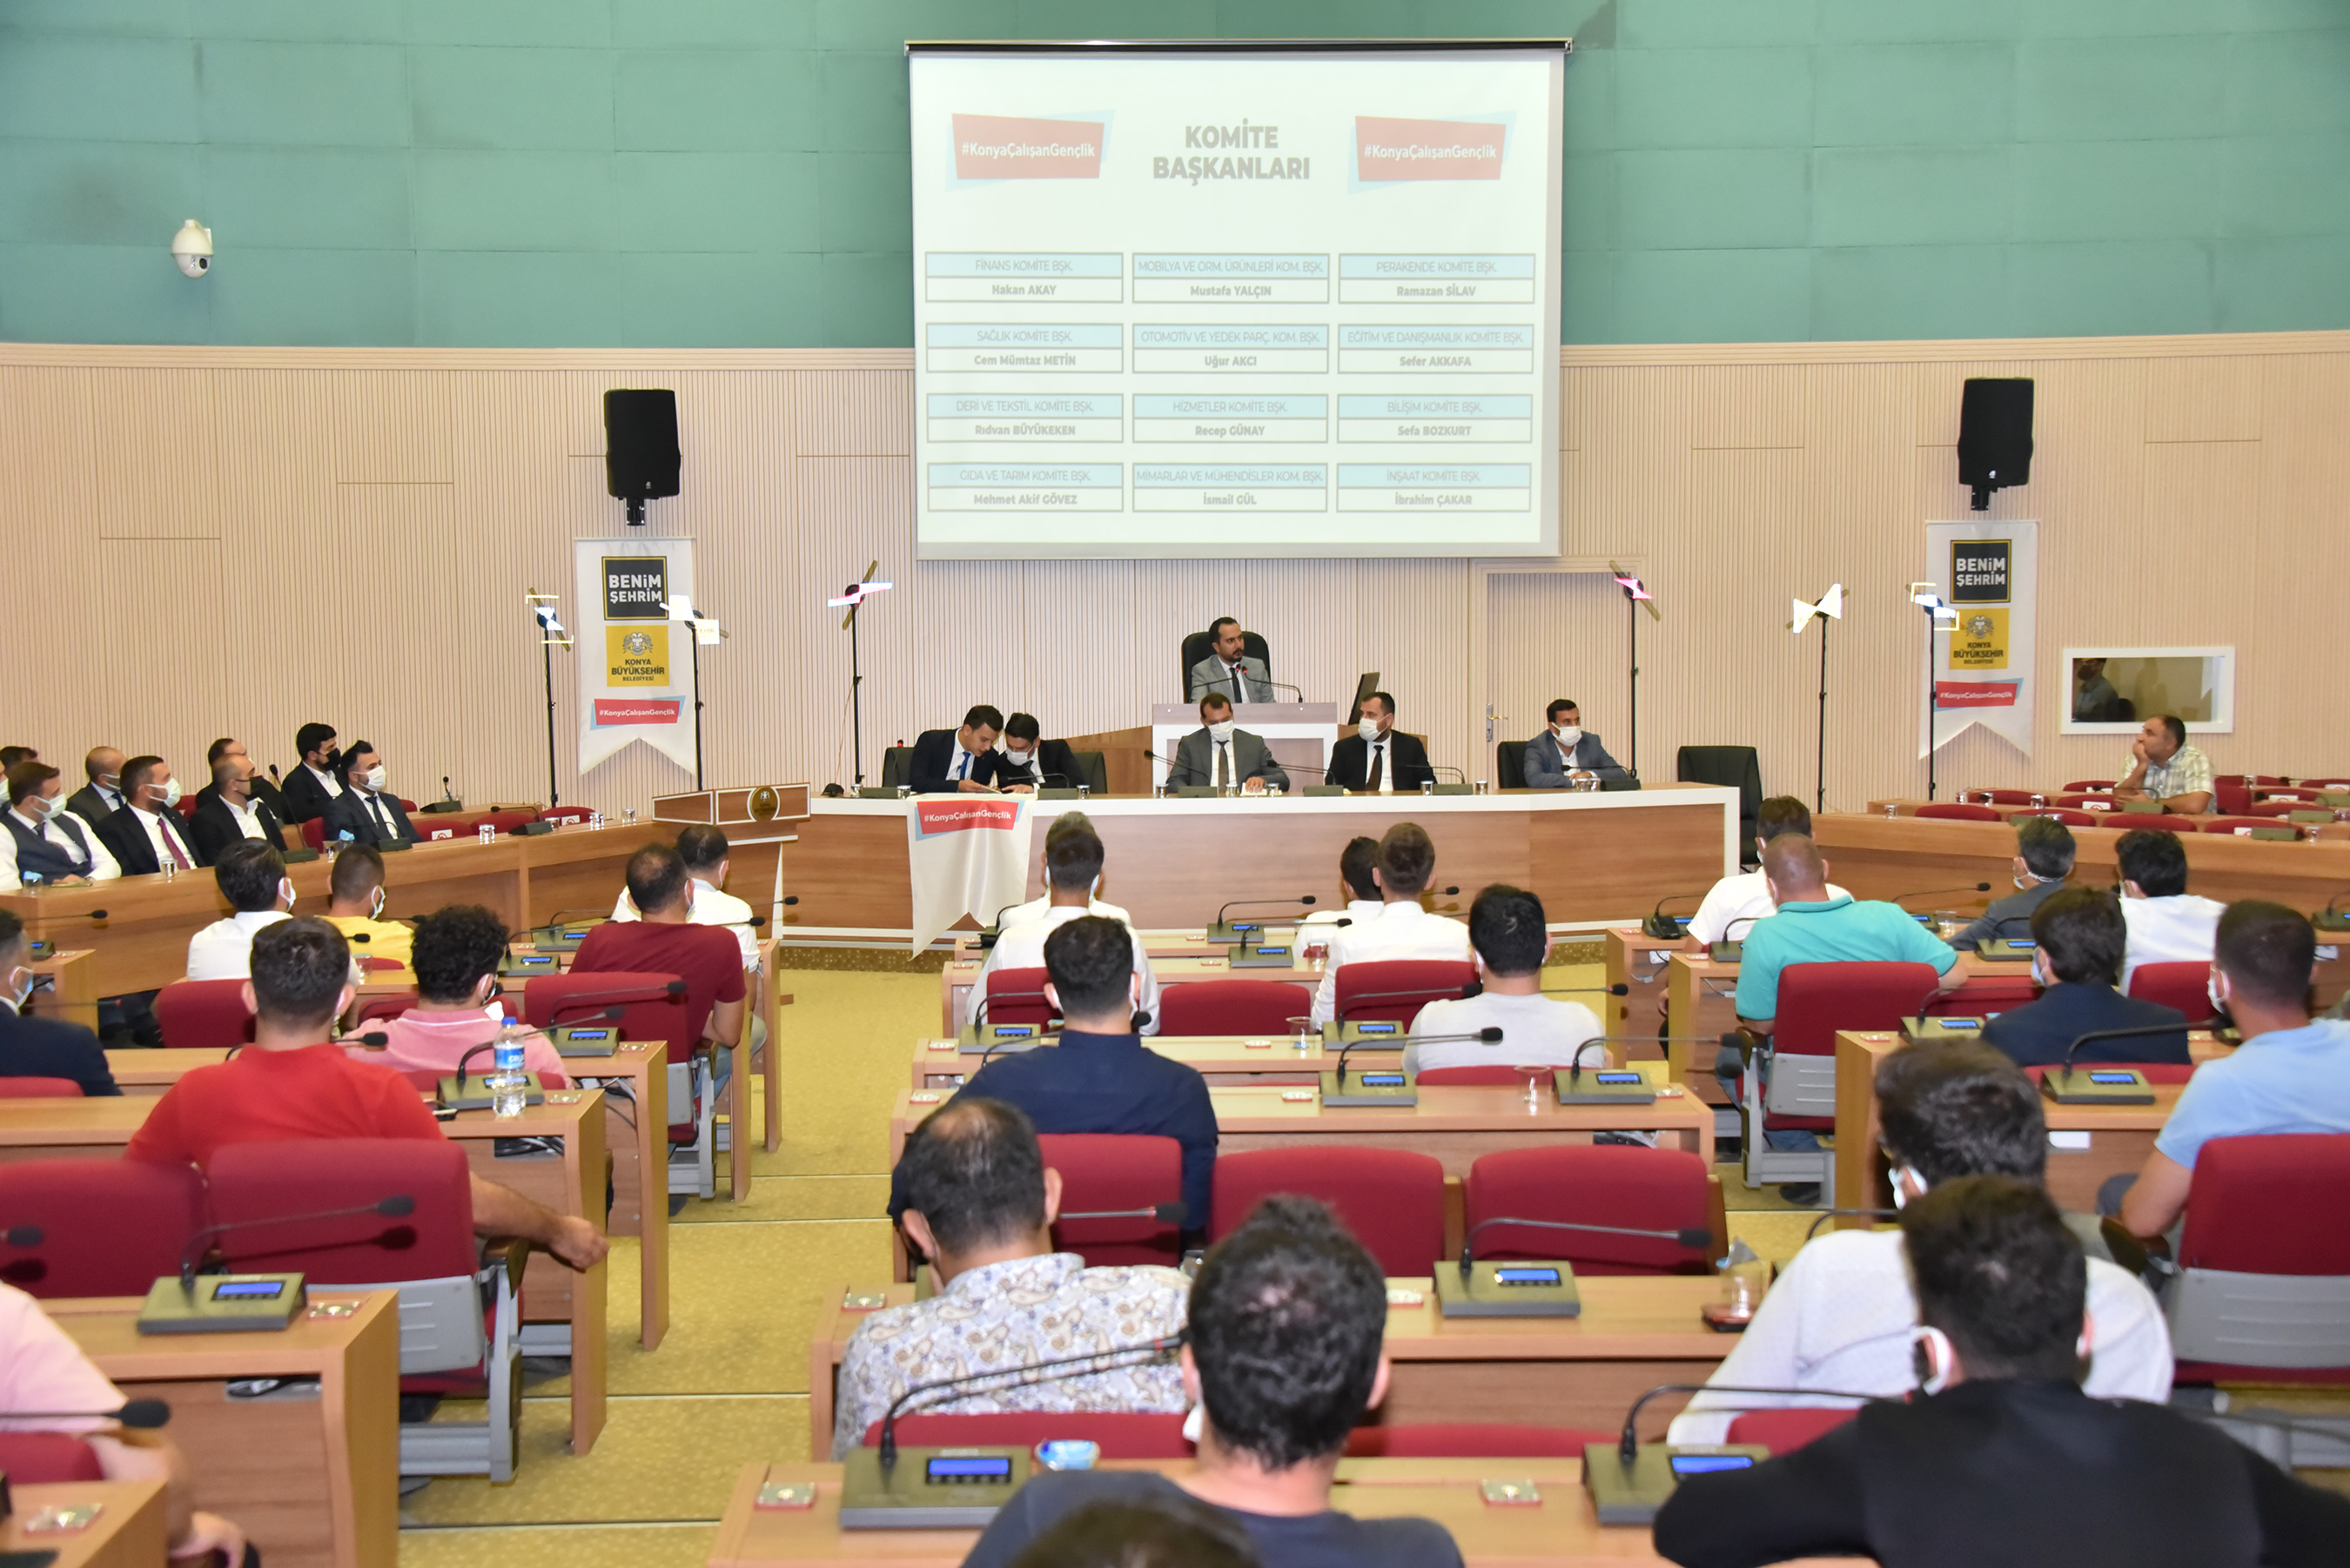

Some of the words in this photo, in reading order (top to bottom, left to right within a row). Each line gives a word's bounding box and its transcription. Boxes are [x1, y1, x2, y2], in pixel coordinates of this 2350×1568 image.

[1185, 118, 1279, 150] KOMİTE
[962, 142, 1095, 160] #KonyaÇalışanGençlik
[1364, 144, 1497, 162] #KonyaÇalışanGençlik
[1152, 157, 1310, 186] BAŞKANLARI
[975, 258, 1010, 271] FİNANS
[1013, 258, 1050, 271] KOMİTE
[1138, 259, 1181, 271] MOBİLYA
[1183, 261, 1195, 271] VE
[1377, 261, 1435, 272] PERAKENDE
[1438, 260, 1474, 272] KOMİTE
[992, 285, 1024, 295] Hakan
[1028, 285, 1057, 295] AKAY
[1191, 285, 1231, 296] Mustafa
[1234, 286, 1271, 298] YALÇIN
[1397, 286, 1443, 296] Ramazan
[1446, 283, 1476, 296] SİLAV
[1013, 329, 1049, 341] KOMİTE
[1194, 332, 1206, 342] VE
[1209, 332, 1240, 342] YEDEK
[1381, 332, 1394, 342] VE
[1397, 332, 1462, 345] DANIŞMANLIK
[1465, 332, 1501, 342] KOMİTE
[975, 355, 997, 365] Cem
[1000, 355, 1041, 365] Mümtaz
[1044, 352, 1076, 365] METİN
[1205, 355, 1230, 368] Uğur
[1400, 356, 1427, 366] Sefer
[1429, 357, 1472, 366] AKKAFA
[957, 399, 978, 412] DERİ
[981, 400, 994, 411] VE
[996, 399, 1032, 412] TEKSTİL
[1035, 399, 1071, 412] KOMİTE
[1173, 401, 1226, 412] HİZMETLER
[1229, 400, 1265, 412] KOMİTE
[1424, 400, 1460, 412] KOMİTE
[976, 425, 1010, 435] Rıdvan
[1013, 423, 1075, 435] BÜYÜKEKEN
[1196, 426, 1226, 438] Recep
[1229, 424, 1265, 435] GÜNAY
[1398, 426, 1420, 436] Sefa
[1423, 426, 1472, 436] BOZKURT
[960, 470, 984, 480] GIDA
[985, 470, 998, 480] VE
[1001, 470, 1030, 480] TARIM
[1032, 469, 1068, 481] KOMİTE
[1137, 469, 1188, 481] MİMARLAR
[1190, 471, 1202, 481] VE
[1386, 470, 1420, 484] İNŞAAT
[1422, 470, 1458, 481] KOMİTE
[974, 494, 1016, 504] Mehmet
[1018, 493, 1040, 504] Akif
[1043, 493, 1078, 505] GÖVEZ
[1204, 492, 1233, 505] İsmail
[1236, 493, 1257, 505] GÜL
[1395, 492, 1434, 505] İbrahim
[1437, 495, 1472, 507] ÇAKAR
[1956, 571, 2006, 587] ŞEHRİM
[609, 587, 662, 604] ŞEHRİM
[611, 666, 665, 676] BÜYÜKŞEHİR
